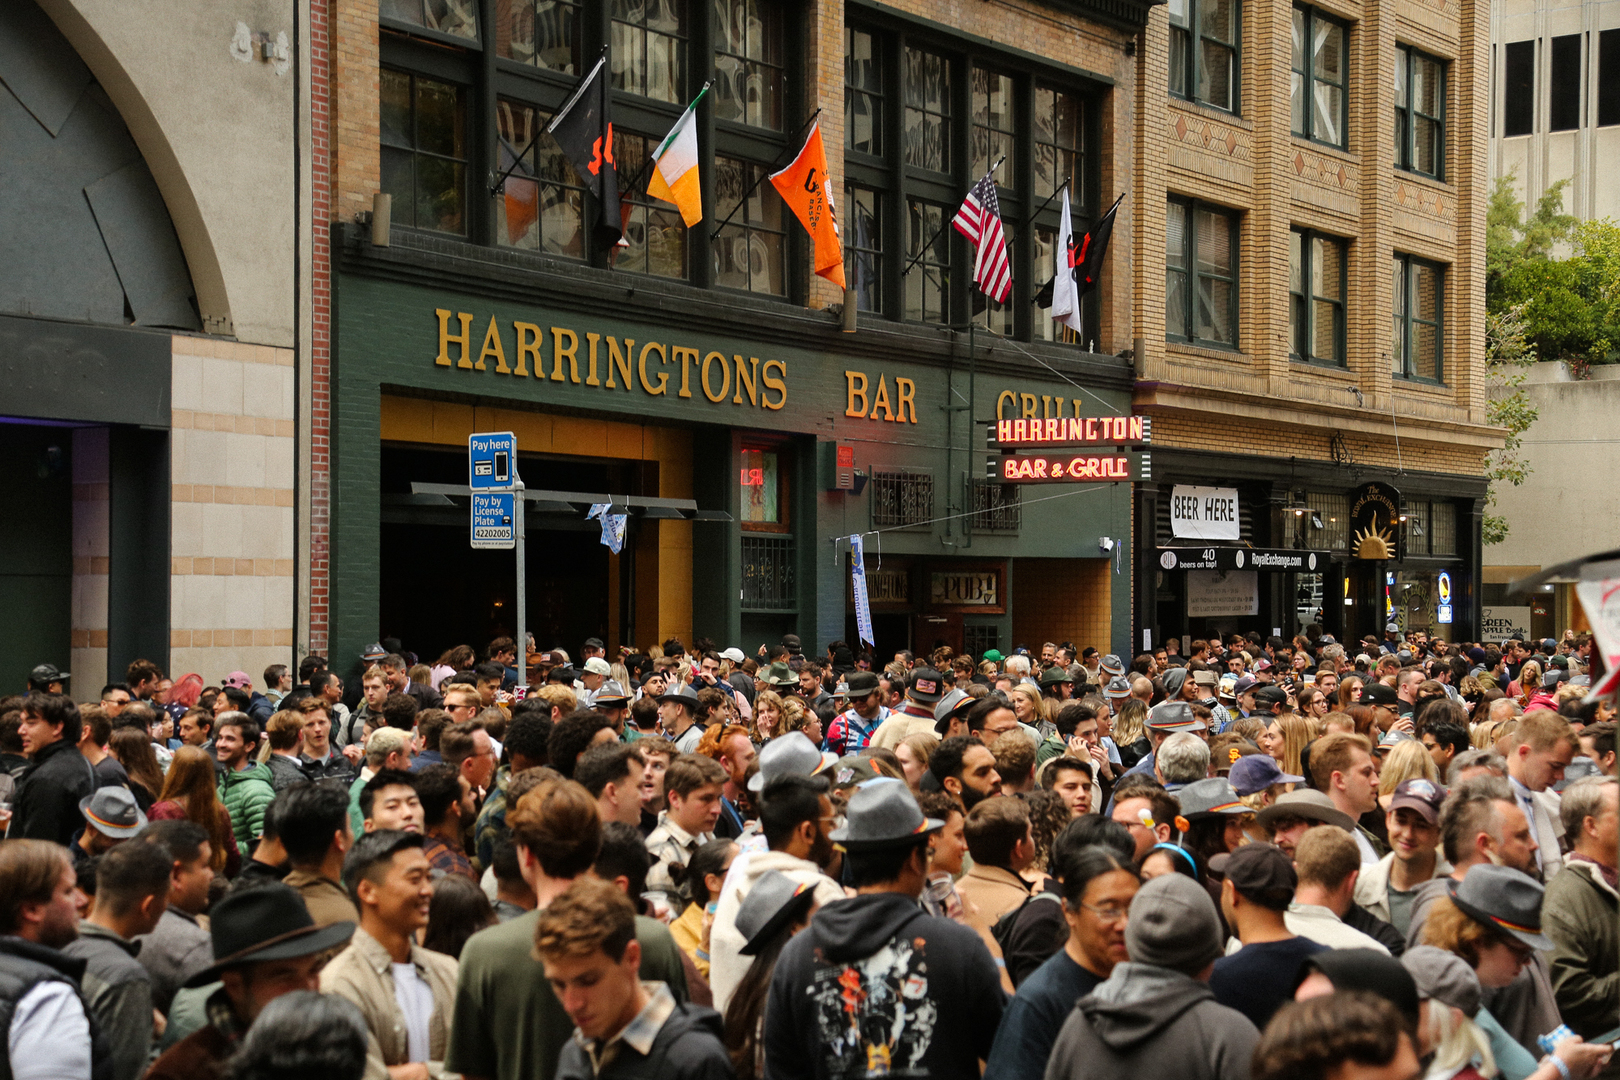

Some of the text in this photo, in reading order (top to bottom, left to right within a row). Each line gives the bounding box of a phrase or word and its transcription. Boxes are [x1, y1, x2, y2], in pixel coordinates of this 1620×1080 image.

[434, 308, 788, 410] HARRINGTONS
[844, 370, 918, 424] BAR
[998, 416, 1143, 442] HARRINGTON
[472, 439, 510, 452] Pay here
[1005, 457, 1128, 478] BAR & GRILL
[475, 496, 502, 508] Pay by
[1174, 495, 1235, 522] BEER HERE
[475, 506, 504, 516] License
[475, 516, 495, 526] Plate
[475, 529, 511, 538] 42202005
[1202, 548, 1216, 561] 40
[1251, 552, 1302, 568] RoyalExchange.com
[1180, 561, 1196, 569] beers
[1205, 560, 1217, 569] tap!
[945, 576, 983, 600] PUB
